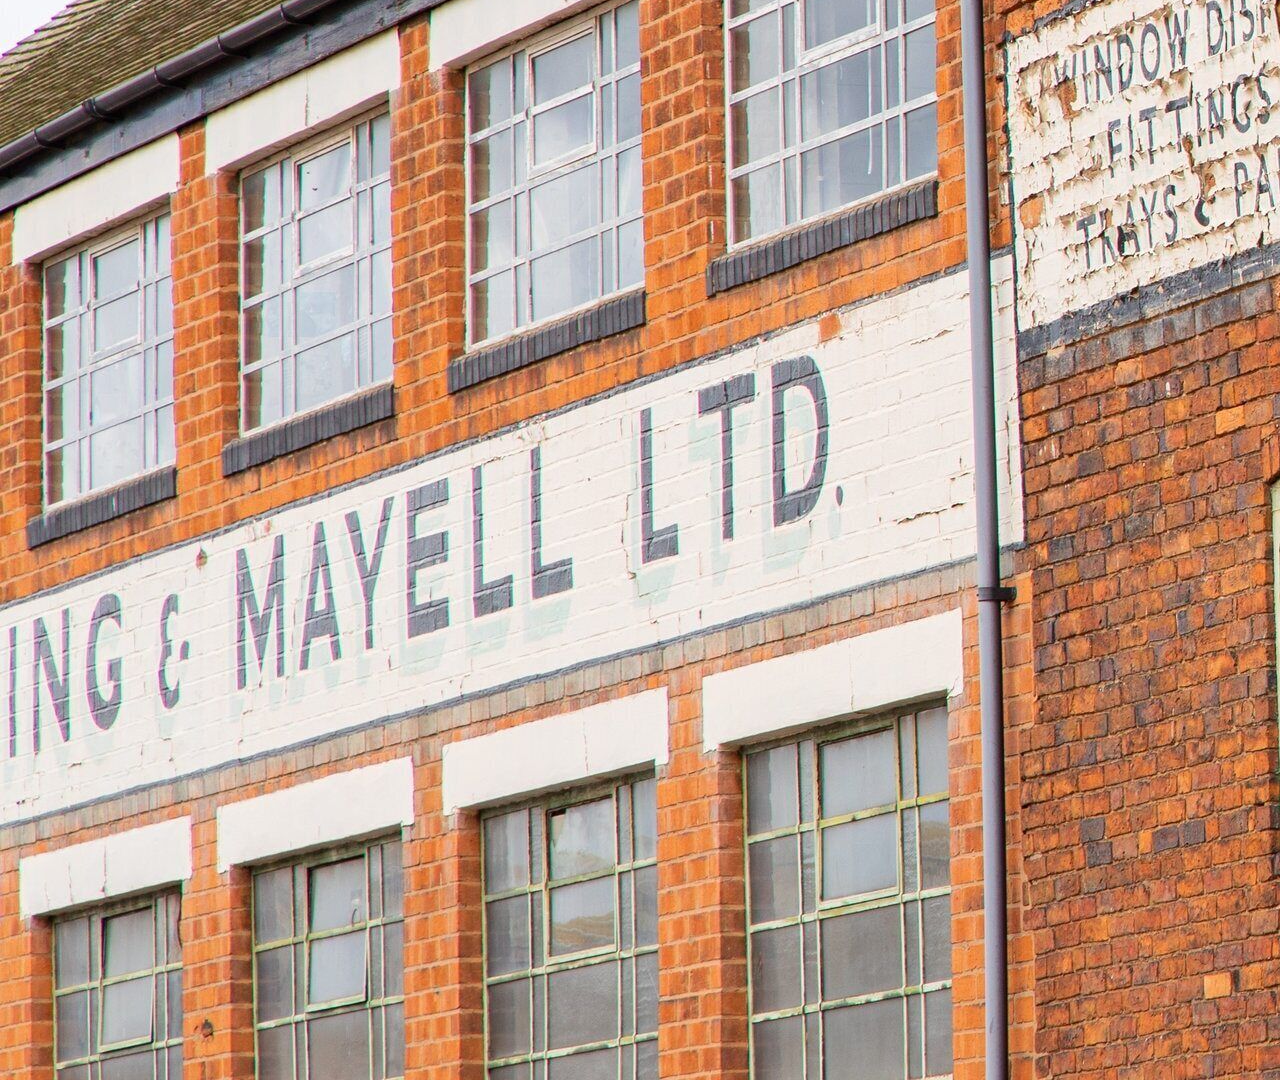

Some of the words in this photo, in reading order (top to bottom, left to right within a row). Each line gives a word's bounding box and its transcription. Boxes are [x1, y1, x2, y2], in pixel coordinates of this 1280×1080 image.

[1106, 69, 1272, 179] FITTINGS
[1075, 183, 1179, 270] TRAYS
[158, 592, 191, 710] &
[235, 445, 574, 691] MAYELL
[639, 355, 844, 564] LTD.
